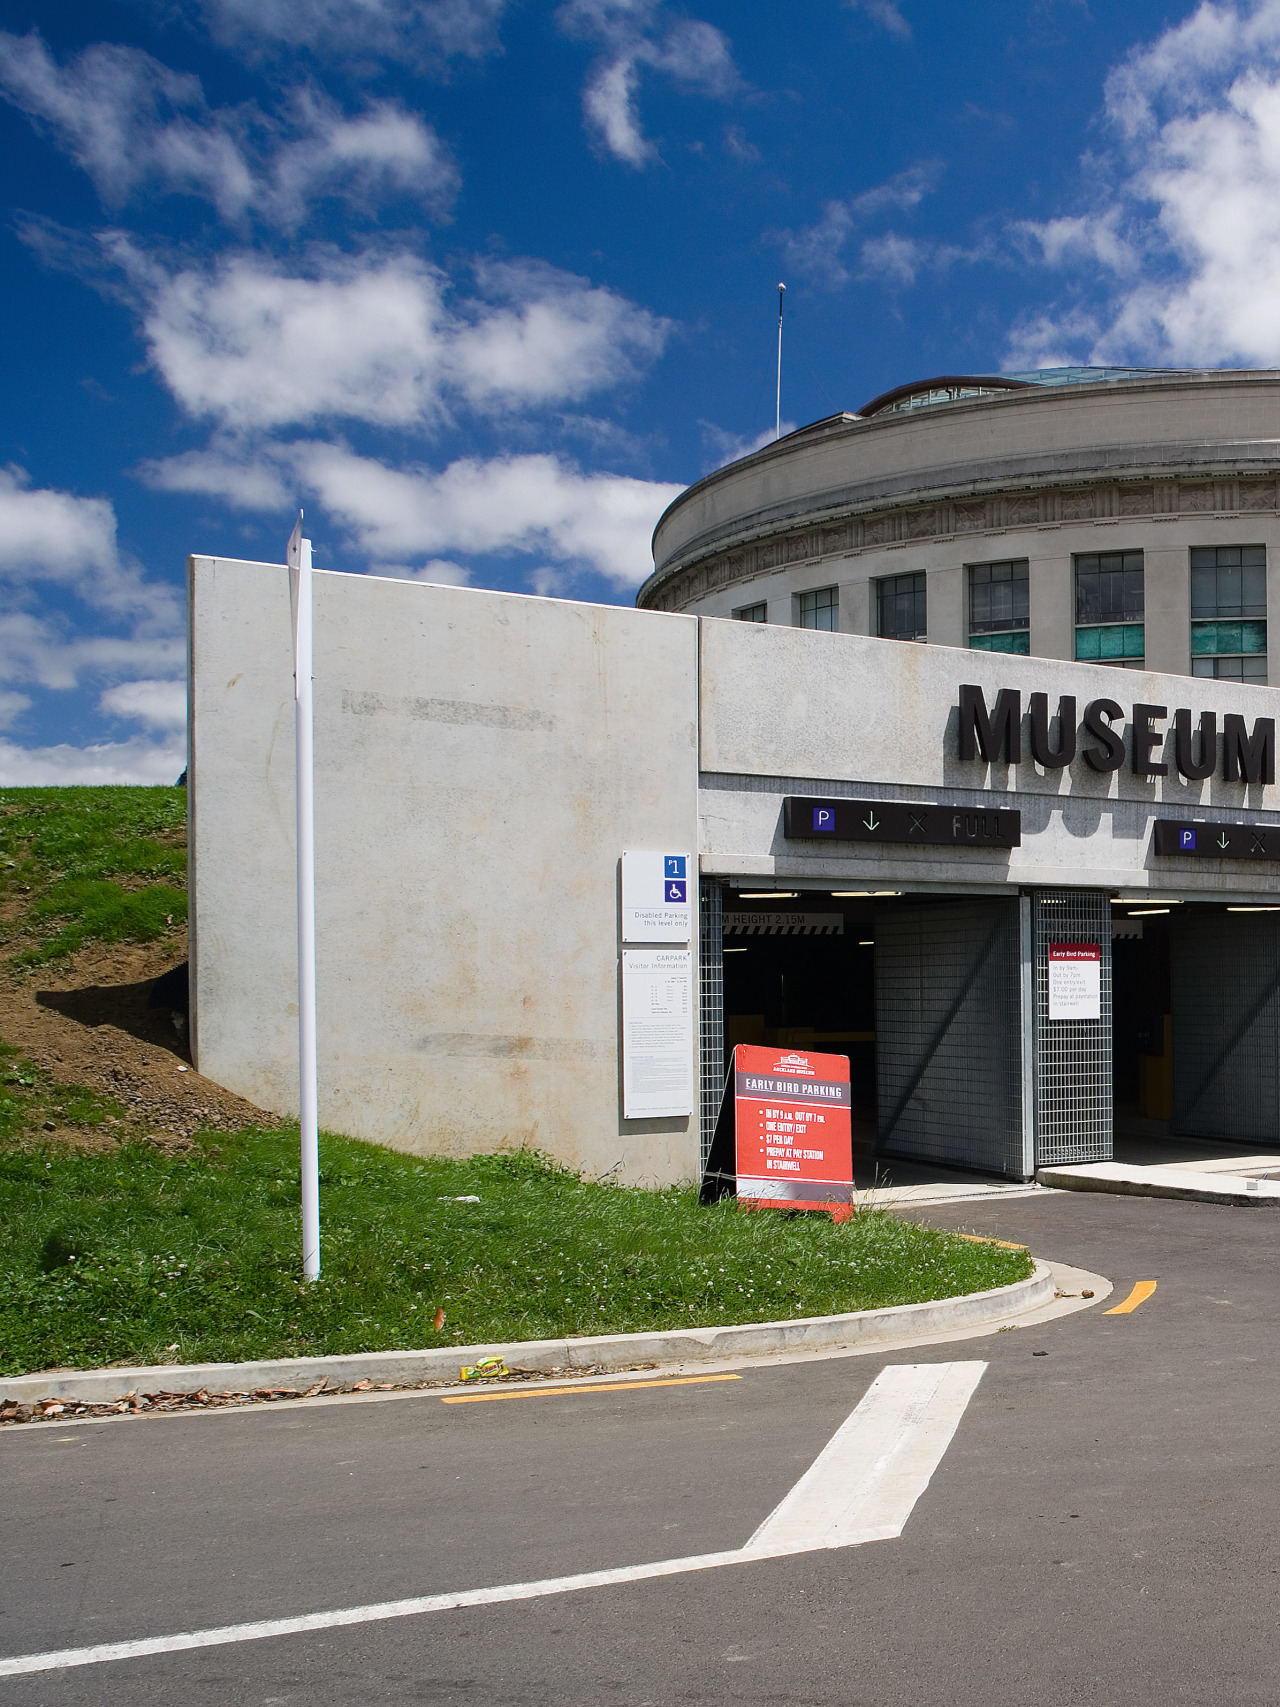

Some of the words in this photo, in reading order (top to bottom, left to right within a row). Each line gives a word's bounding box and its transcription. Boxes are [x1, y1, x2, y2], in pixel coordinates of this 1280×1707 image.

[958, 684, 1276, 785] MUSEUM
[818, 810, 830, 826] P
[952, 815, 1005, 838] FULL
[1183, 832, 1192, 845] P
[734, 914, 772, 924] HEIGHT
[775, 915, 805, 925] 2.15M
[746, 1078, 774, 1090] EARLY
[777, 1082, 800, 1093] BIRD
[802, 1084, 842, 1096] PARKING
[773, 1110, 780, 1118] BY
[780, 1110, 784, 1119] 9
[795, 1112, 805, 1121] OUT
[814, 1114, 816, 1122] 7
[766, 1134, 772, 1144] $7
[773, 1135, 783, 1144] PER
[784, 1136, 793, 1145] DAY
[766, 1147, 785, 1157] PREPAY
[793, 1149, 802, 1158] PAY
[804, 1150, 824, 1160] STATION
